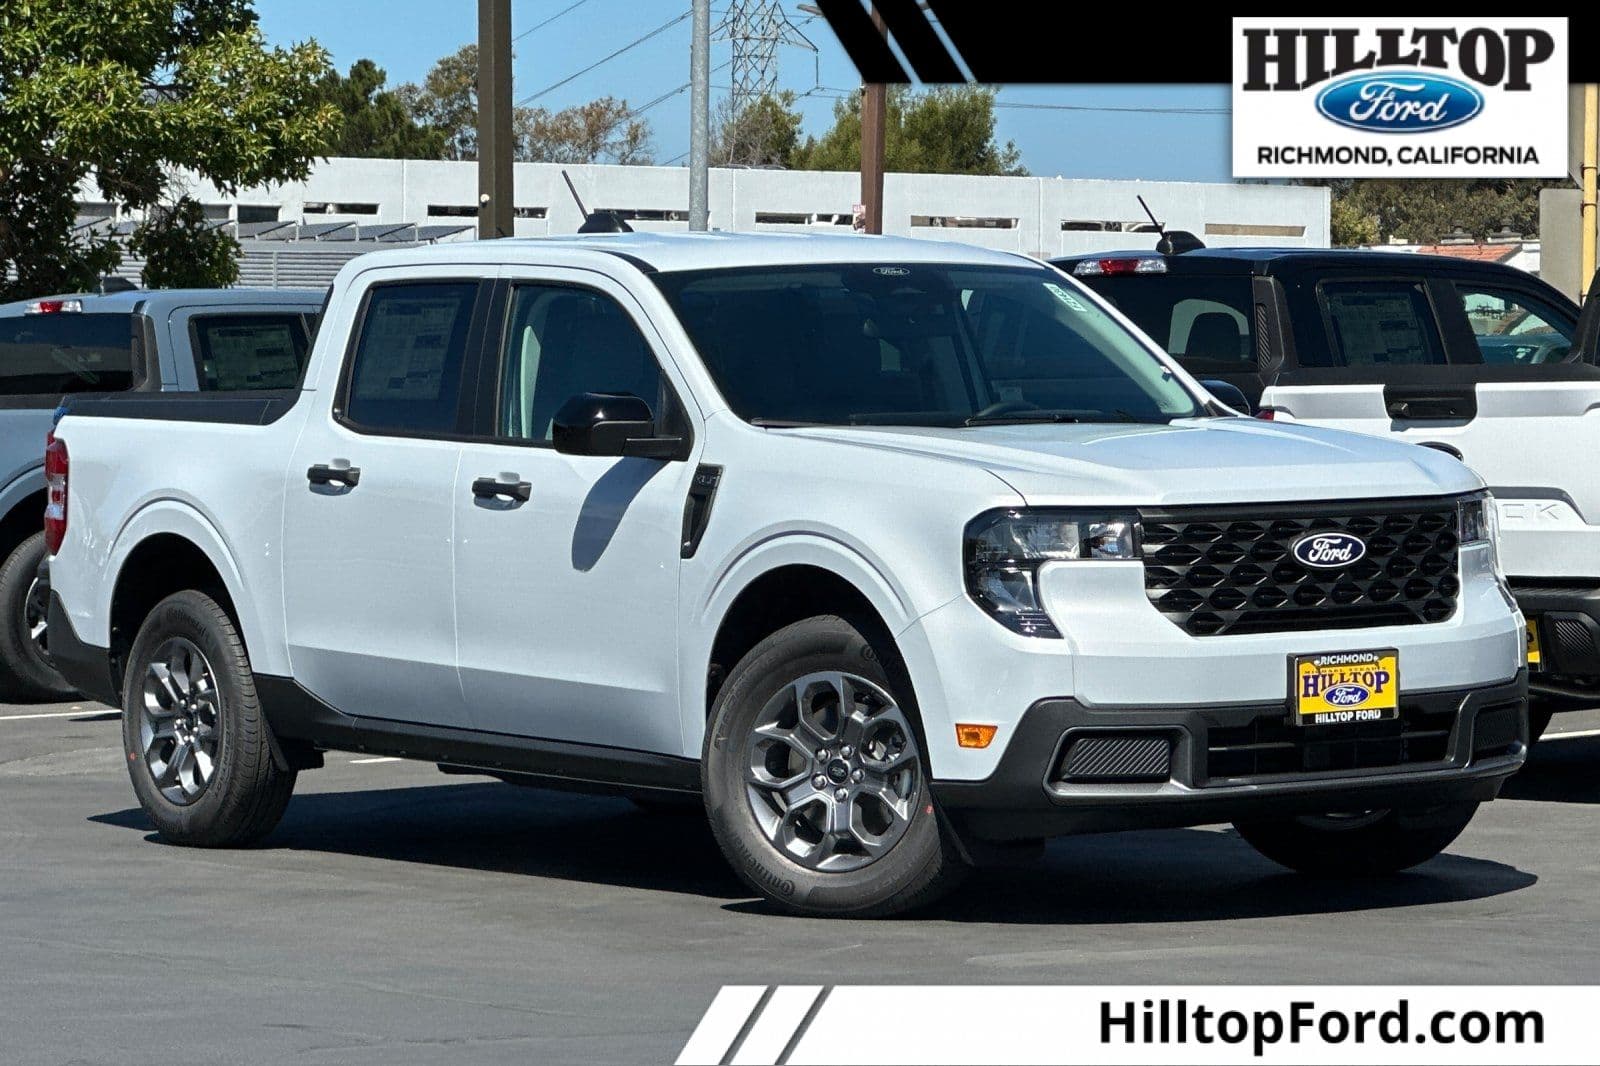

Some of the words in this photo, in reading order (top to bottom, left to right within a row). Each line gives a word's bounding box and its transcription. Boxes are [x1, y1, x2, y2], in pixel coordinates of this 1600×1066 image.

[1308, 537, 1353, 562] Ford
[1320, 653, 1373, 665] RICHMOND
[1302, 671, 1390, 698] HILLTOP
[1332, 687, 1362, 704] Ford
[1315, 711, 1354, 724] HILLTOP
[1355, 709, 1381, 721] FORD
